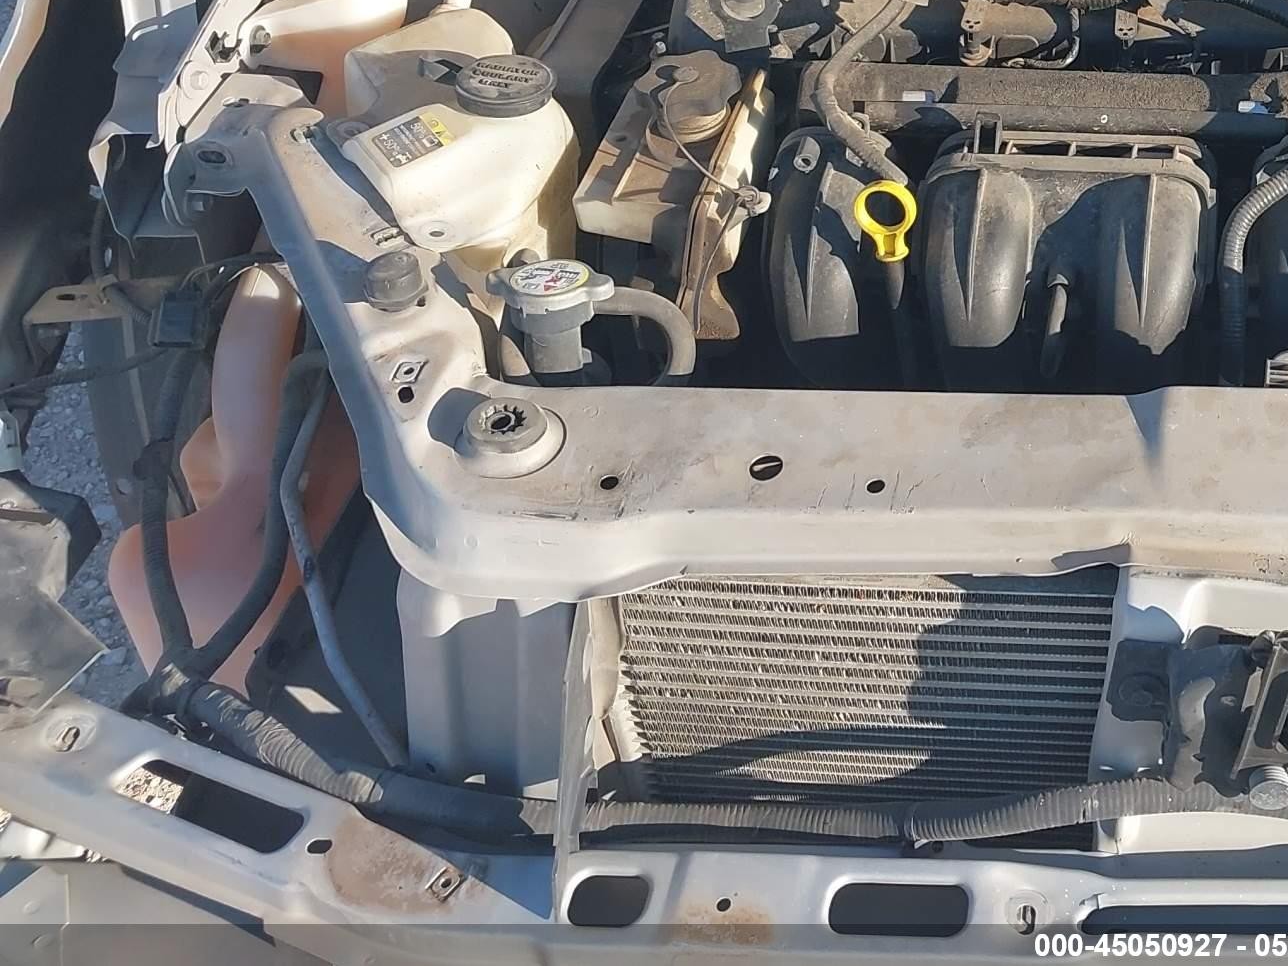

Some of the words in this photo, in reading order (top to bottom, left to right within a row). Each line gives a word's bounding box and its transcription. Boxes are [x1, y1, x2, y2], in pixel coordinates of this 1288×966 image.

[471, 68, 534, 84] COOLANT
[475, 61, 540, 76] RADIATOR
[477, 77, 512, 89] ONLY
